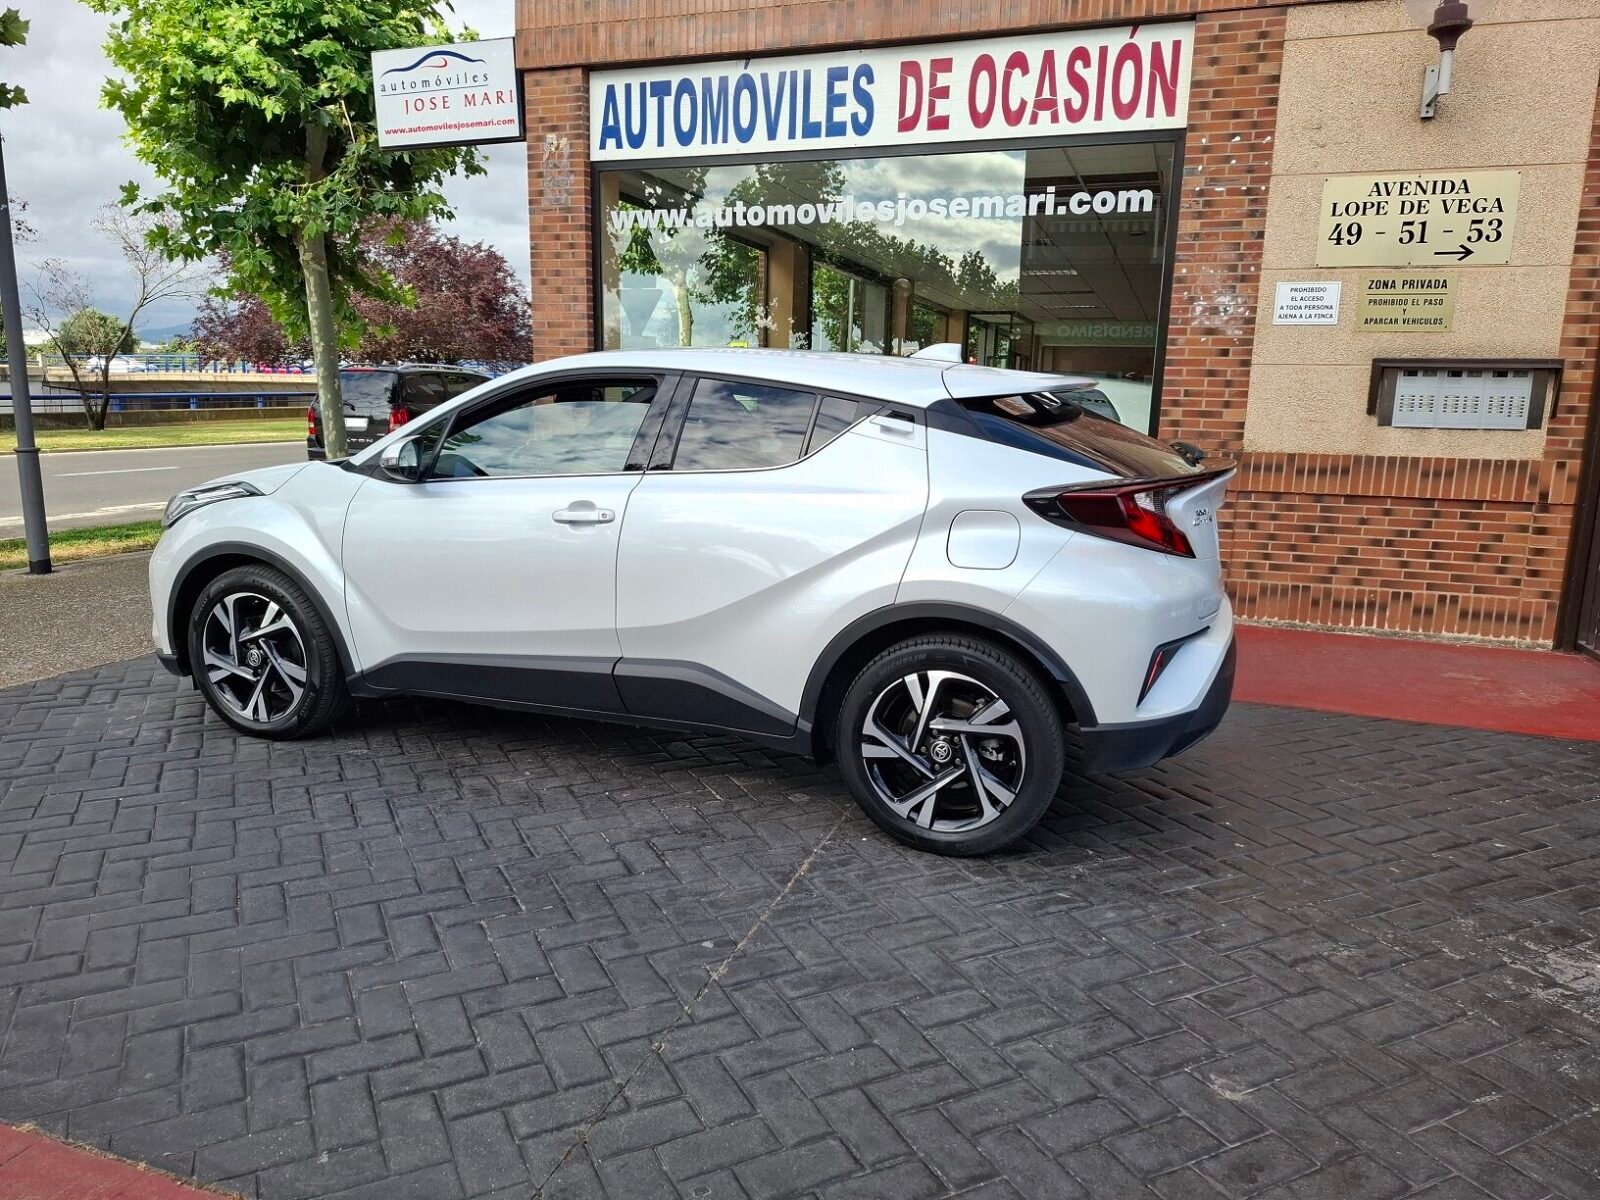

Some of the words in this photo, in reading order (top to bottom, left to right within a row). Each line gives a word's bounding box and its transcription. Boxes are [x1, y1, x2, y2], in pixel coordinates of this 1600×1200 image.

[380, 71, 489, 93] automóviles
[599, 59, 876, 151] AUTOMÓVILES
[897, 57, 953, 133] DE
[968, 26, 1182, 129] OCASIÓN
[404, 95, 451, 115] JOSE
[464, 89, 514, 108] MARI
[384, 118, 516, 136] www.automovilesjosemari.com
[1368, 179, 1471, 197] AVENIDA
[611, 187, 1154, 229] www.automovilesjosemari.com
[1330, 200, 1389, 217] LOPE
[1399, 199, 1430, 216] DE
[1441, 197, 1505, 215] VEGA
[1328, 221, 1363, 246] 49
[1398, 220, 1429, 245] 51
[1466, 218, 1503, 243] 53
[1368, 279, 1396, 289] ZONA
[1401, 279, 1448, 289] PRIVADA
[1368, 298, 1409, 306] PROHIBIDO
[1411, 298, 1420, 306] EL
[1423, 298, 1444, 306] PASO
[1364, 317, 1399, 325] APARCAR
[1402, 317, 1444, 325] VEHICULOS
